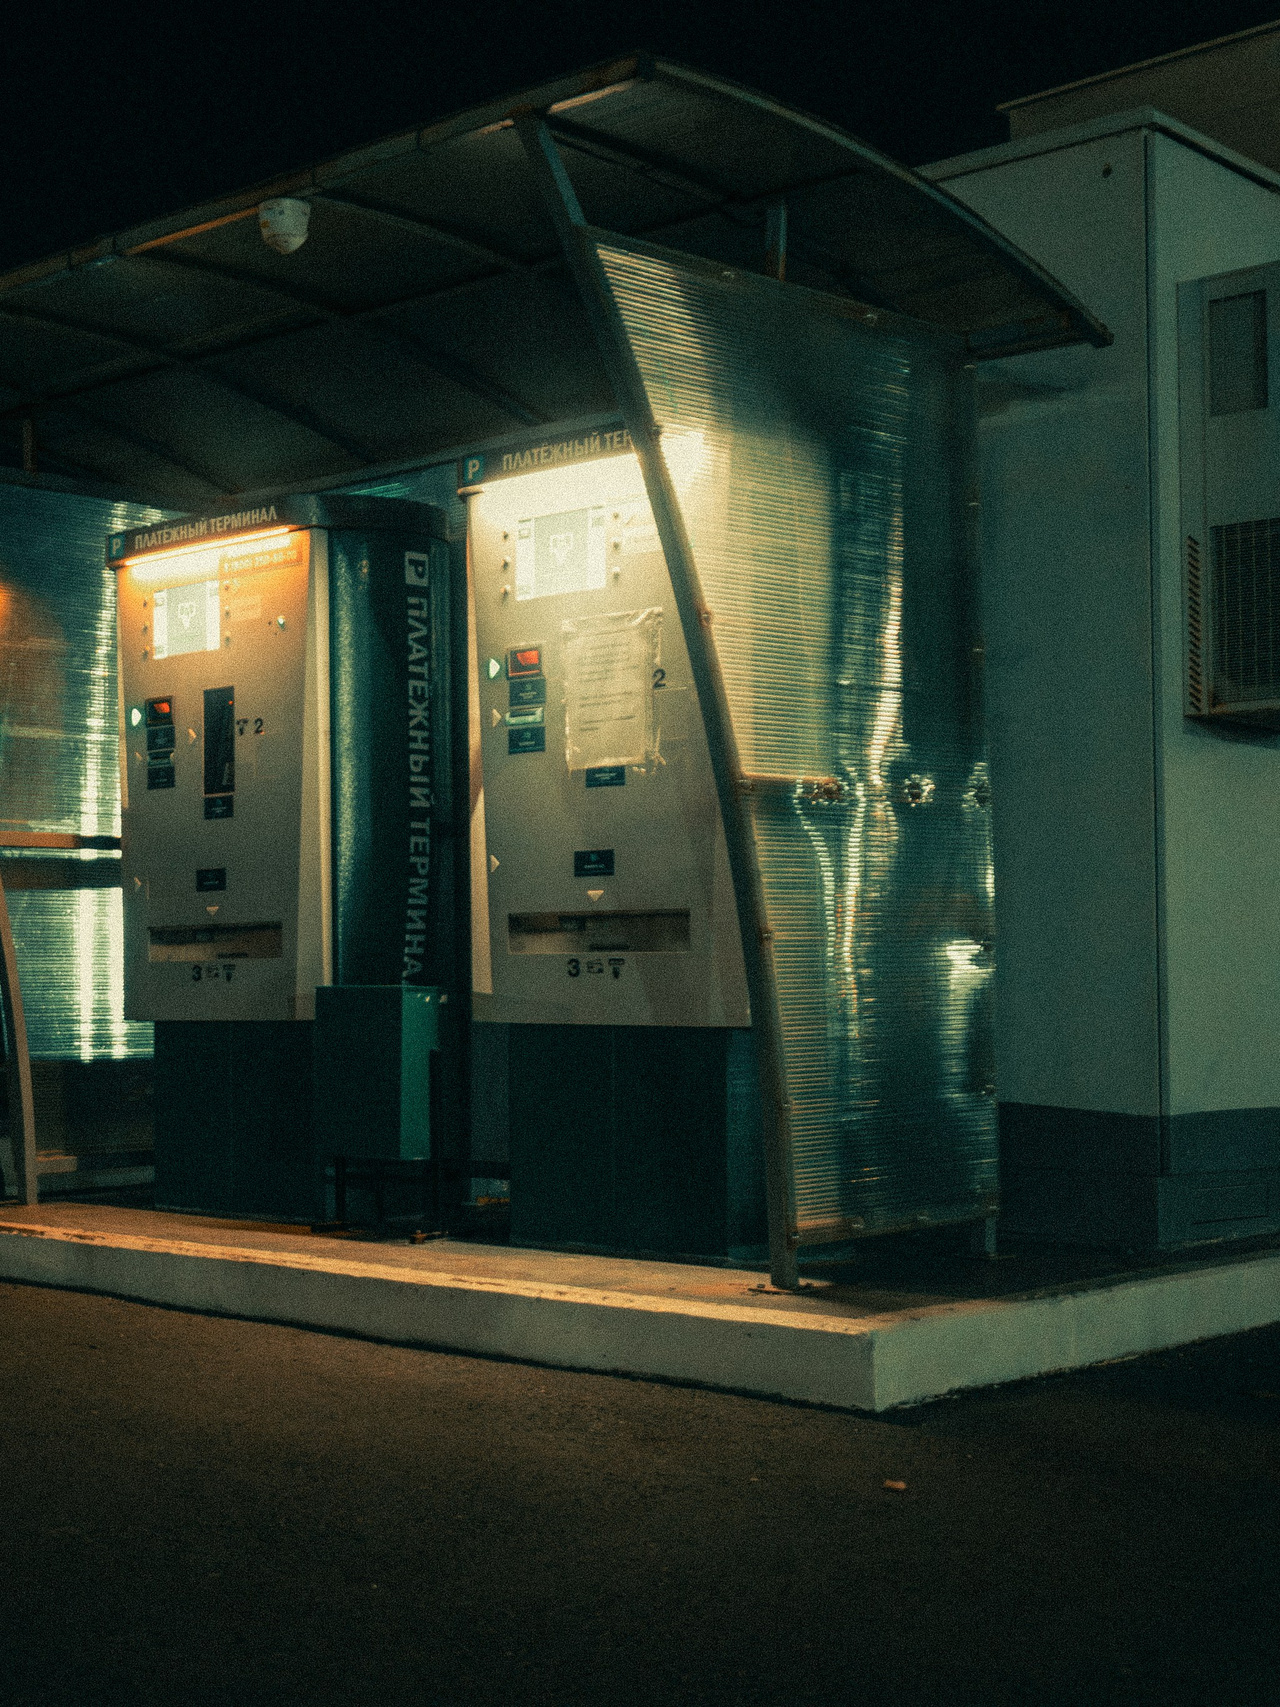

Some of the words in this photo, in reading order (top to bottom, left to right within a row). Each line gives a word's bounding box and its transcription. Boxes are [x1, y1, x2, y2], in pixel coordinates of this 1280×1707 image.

[210, 505, 278, 533] ТЕРМИНАЛ
[652, 668, 666, 689] 2
[254, 717, 264, 733] 2
[402, 817, 430, 986] ТЕРМИНА
[192, 965, 202, 981] 3
[567, 958, 581, 977] 3
